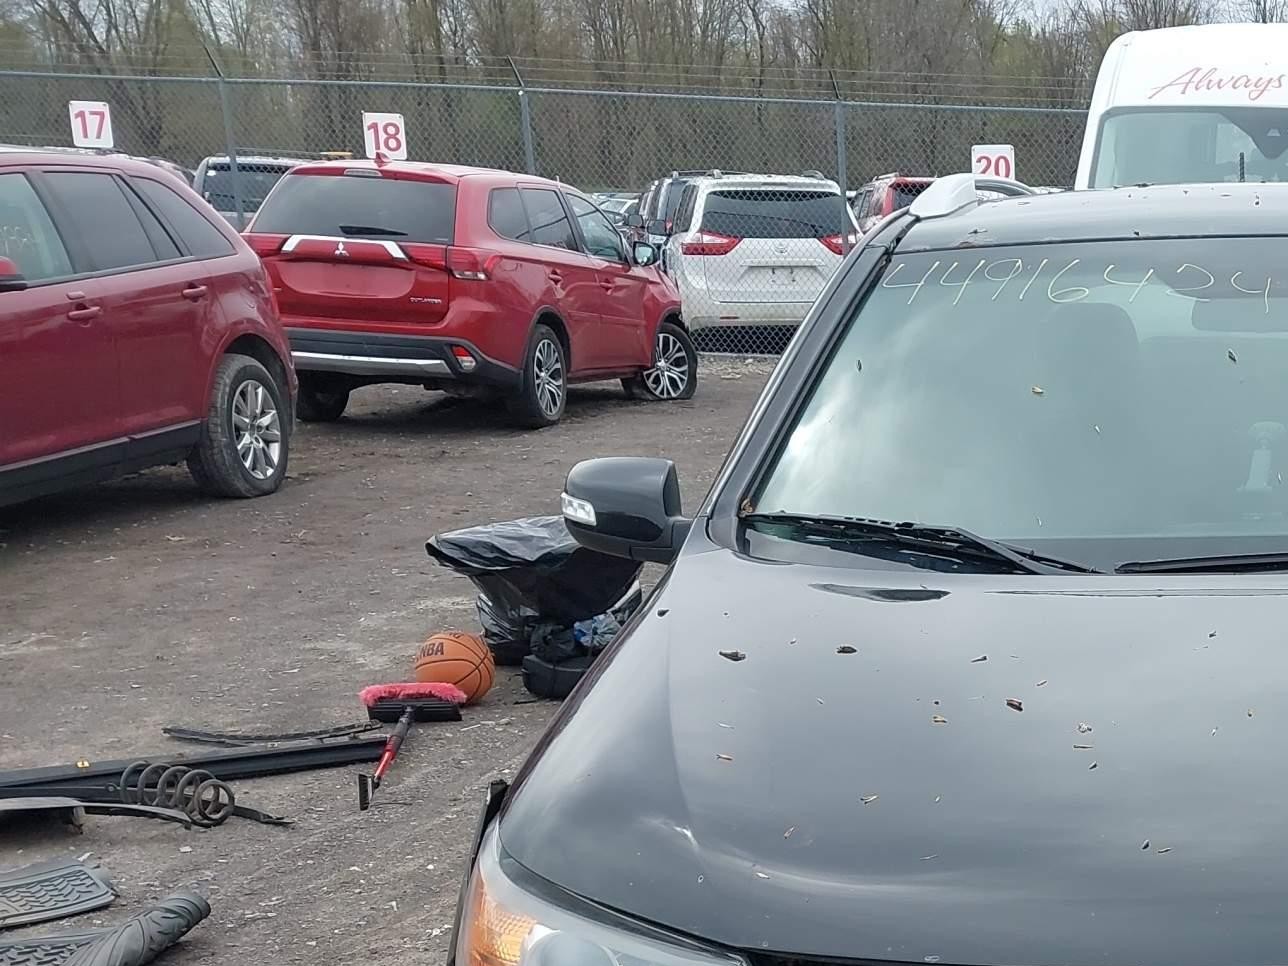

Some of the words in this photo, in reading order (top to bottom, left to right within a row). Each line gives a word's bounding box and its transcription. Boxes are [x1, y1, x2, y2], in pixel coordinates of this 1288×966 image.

[1148, 67, 1286, 101] Always
[74, 110, 105, 139] 17
[367, 121, 402, 152] 18
[975, 155, 1011, 178] 20
[420, 641, 445, 658] NBA
